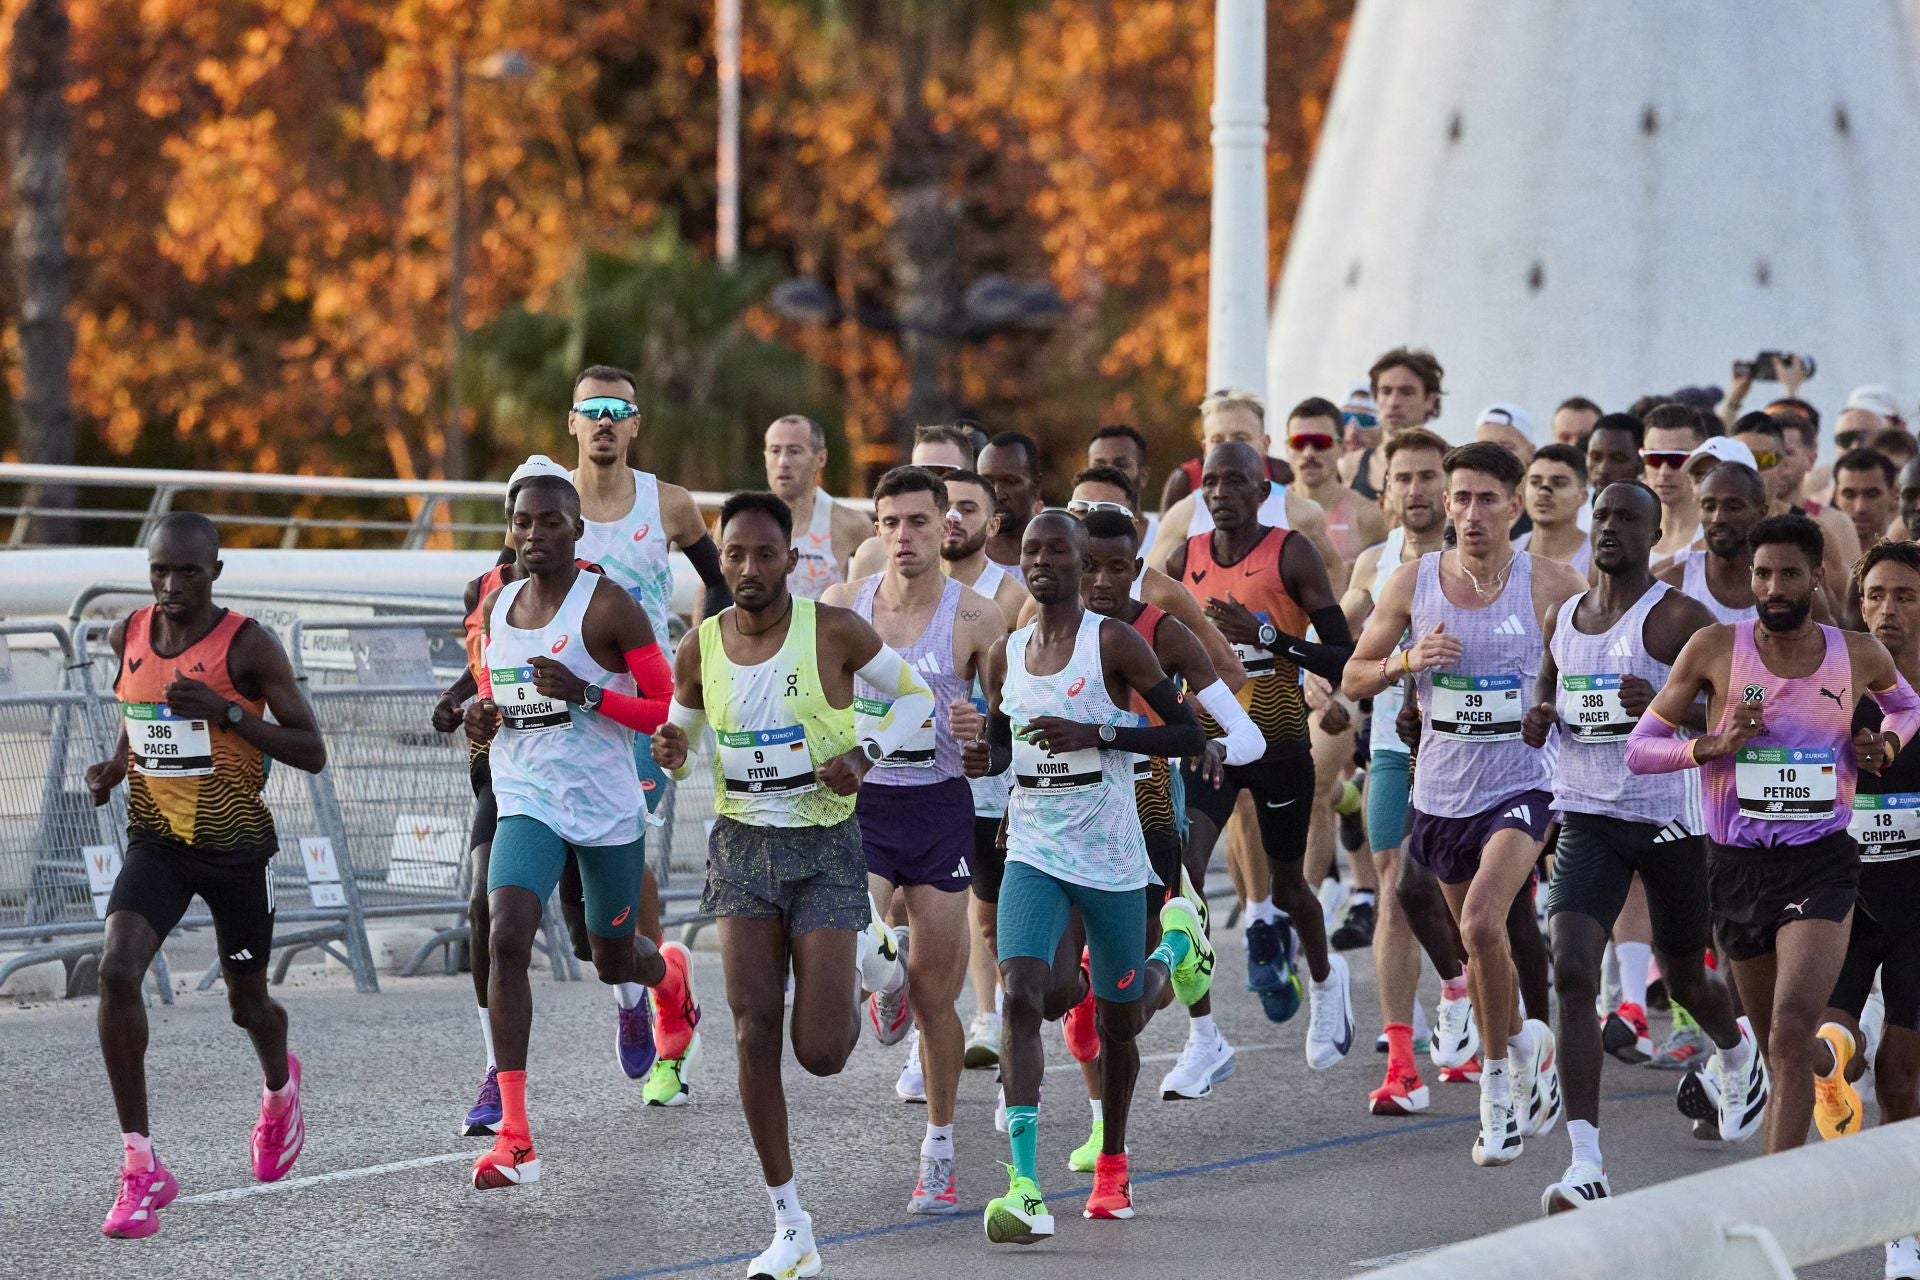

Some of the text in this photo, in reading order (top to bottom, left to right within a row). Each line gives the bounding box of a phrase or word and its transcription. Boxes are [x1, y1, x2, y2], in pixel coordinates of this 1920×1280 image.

[517, 687, 525, 701] 6
[1465, 694, 1483, 708] 39
[1582, 694, 1604, 708] 388
[509, 701, 553, 717] KIPKOECH
[1456, 710, 1493, 722] PACER
[1579, 711, 1610, 723] PACER
[147, 725, 172, 739] 386
[771, 731, 794, 741] ZURICH
[144, 743, 179, 756] PACER
[754, 750, 764, 764] 9
[747, 766, 779, 780] FITWI
[1036, 762, 1070, 774] KORIR
[1778, 768, 1797, 782] 10
[1763, 786, 1811, 798] PETROS
[1874, 813, 1893, 827] 18
[1863, 829, 1907, 842] CRIPPA
